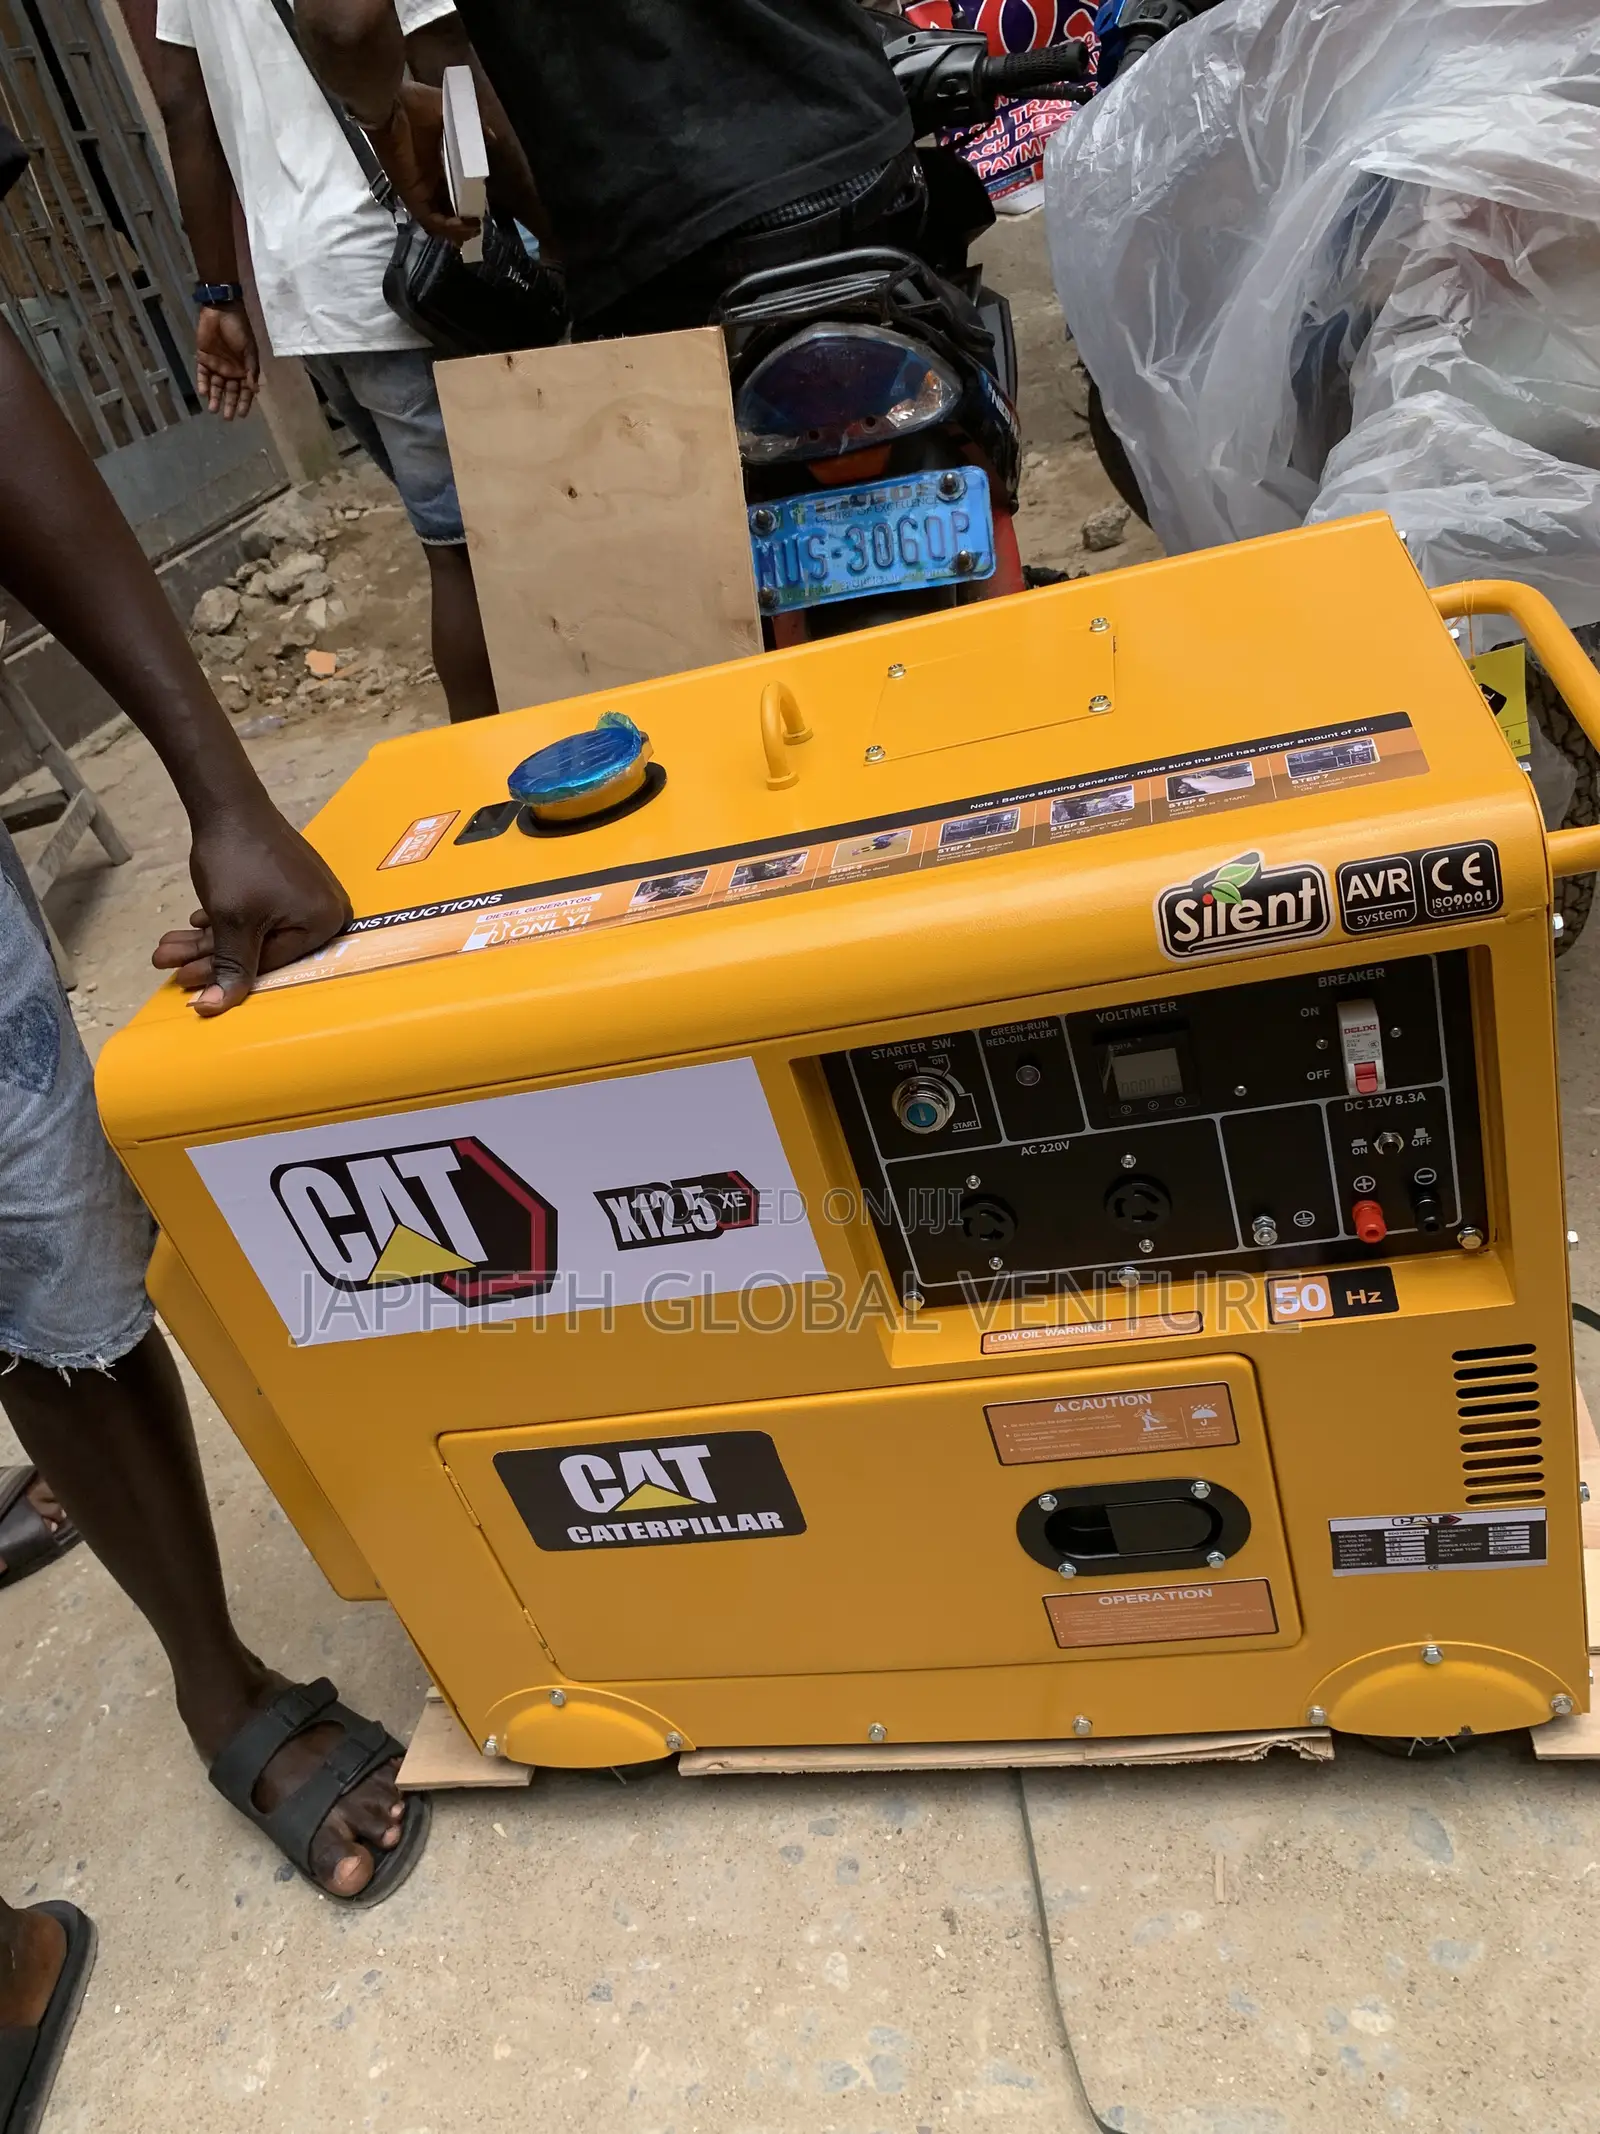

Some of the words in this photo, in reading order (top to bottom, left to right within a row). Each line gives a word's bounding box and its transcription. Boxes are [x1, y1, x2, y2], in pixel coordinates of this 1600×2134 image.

[970, 800, 994, 810] Note
[1002, 792, 1036, 804] Before
[1038, 783, 1076, 797] starting
[1078, 773, 1129, 789] generator
[1137, 765, 1166, 776] make
[1168, 760, 1193, 770] sure
[1193, 755, 1211, 766] the
[1213, 751, 1235, 761] unit
[1236, 746, 1256, 757] has
[1258, 739, 1295, 754] proper
[1297, 731, 1338, 744] amount
[1341, 728, 1353, 737] of
[1291, 775, 1321, 785] STEP
[1168, 799, 1197, 809] STEP
[1050, 822, 1078, 832] STEP
[938, 844, 964, 854] STEP
[829, 865, 856, 875] STEP
[1346, 867, 1409, 903] AVR
[485, 909, 521, 921] DIESEL
[524, 896, 593, 913] GENERATOR
[1431, 889, 1493, 910] ISO9001
[348, 893, 503, 932] INSTRUCTIONS
[515, 911, 561, 925] DIESEL
[562, 904, 594, 916] FUEL
[1173, 876, 1317, 943] Silent
[1356, 906, 1408, 927] system
[1317, 967, 1387, 989] BREAKER
[1095, 1001, 1178, 1024] VOLTMETER
[1300, 1006, 1320, 1018] ON
[985, 1033, 1027, 1047] RED-OIL
[1027, 1028, 1059, 1042] ALERT
[990, 1020, 1050, 1037] GREEN-RUN
[1343, 1024, 1378, 1035] DELIXI
[870, 1042, 928, 1060] STARTER
[931, 1038, 956, 1051] SW.
[896, 1061, 914, 1071] OFF
[931, 1056, 946, 1067] ON
[1306, 1068, 1331, 1082] OFF
[1344, 1100, 1364, 1112] DC
[1367, 1096, 1393, 1109] 12V
[1395, 1091, 1427, 1106] 8.3A
[952, 1119, 977, 1130] START
[1020, 1144, 1037, 1156] AC
[1038, 1140, 1071, 1154] 220V
[1351, 1146, 1369, 1156] ON
[1411, 1136, 1433, 1147] OFF
[279, 1145, 490, 1284] CAT
[1274, 1283, 1327, 1315] 50
[1346, 1289, 1384, 1306] Hz
[989, 1332, 1019, 1343] LOW
[1021, 1330, 1040, 1340] OIL
[1044, 1321, 1113, 1337] WARNING!
[1066, 1393, 1153, 1413] CAUTION
[559, 1444, 718, 1514] CAT
[566, 1510, 785, 1544] CATERPILLAR
[1392, 1515, 1444, 1527] CAT
[1098, 1588, 1213, 1606] OPERATION
